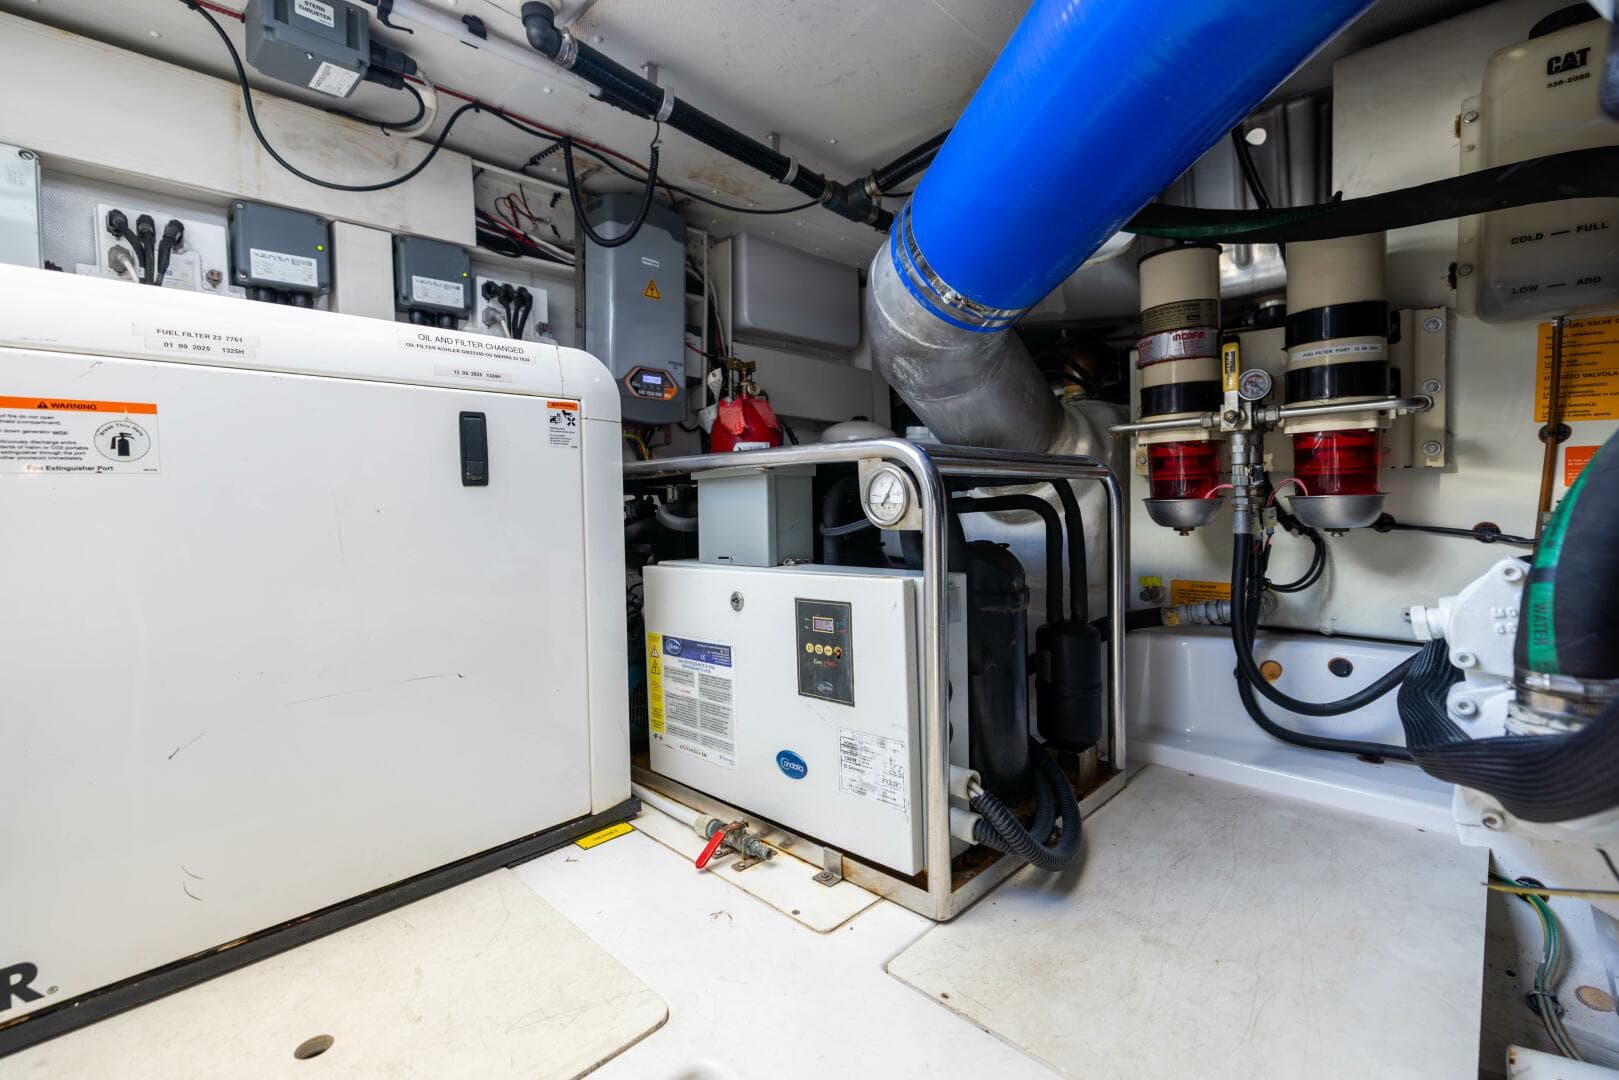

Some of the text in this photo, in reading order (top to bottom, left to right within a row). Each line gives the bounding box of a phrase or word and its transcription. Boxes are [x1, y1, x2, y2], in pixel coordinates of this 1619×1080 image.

[298, 4, 332, 21] THRUSTER
[305, 1, 325, 12] STERN
[1547, 47, 1591, 76] CAT
[1511, 222, 1609, 245] COLD FULL
[1512, 275, 1602, 295] LOW ADD
[1587, 318, 1613, 327] VALVE
[182, 331, 210, 340] FILTER
[417, 333, 524, 355] OIL AND FILTER CHANGED
[1584, 370, 1619, 379] VALVOLA
[50, 402, 98, 411] WARNING
